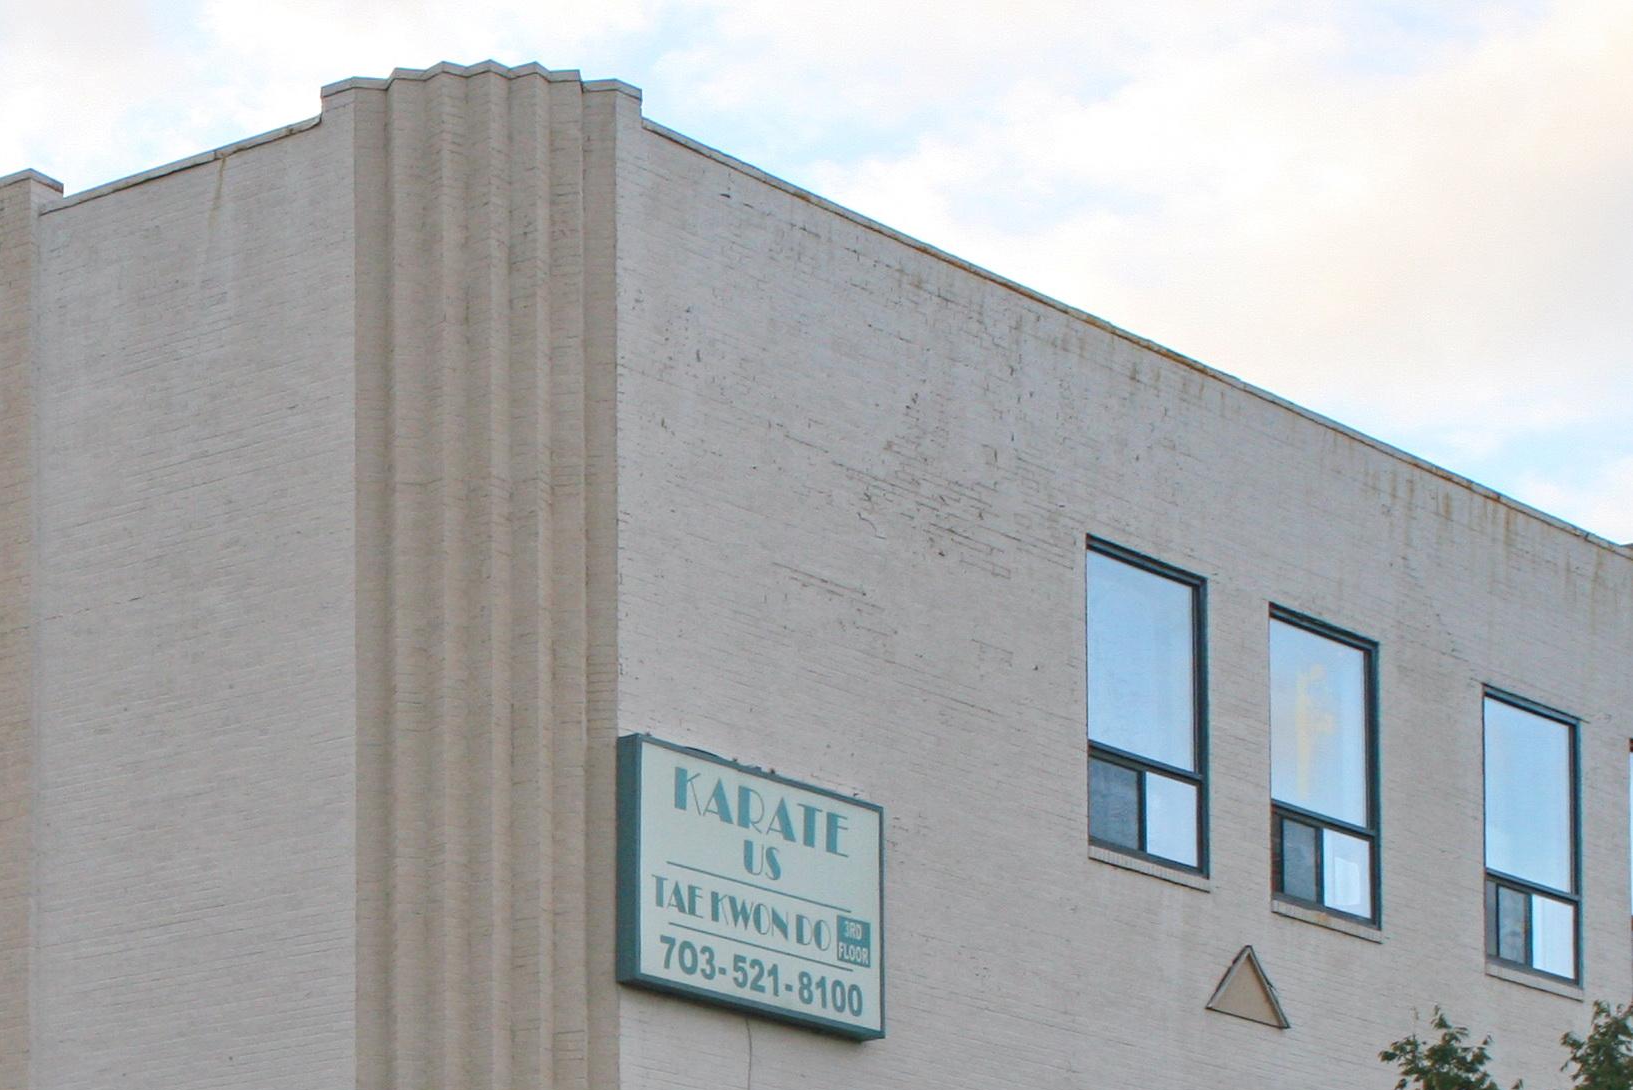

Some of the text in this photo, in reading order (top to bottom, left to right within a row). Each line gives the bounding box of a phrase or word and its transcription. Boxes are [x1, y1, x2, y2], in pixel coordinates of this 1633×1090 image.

[674, 766, 849, 858] KARATE
[743, 839, 782, 881] US
[651, 874, 832, 951] TAE KWON DO
[843, 920, 863, 938] 3RD
[659, 934, 863, 1017] 703-521-8100
[839, 942, 869, 964] FLOOR
